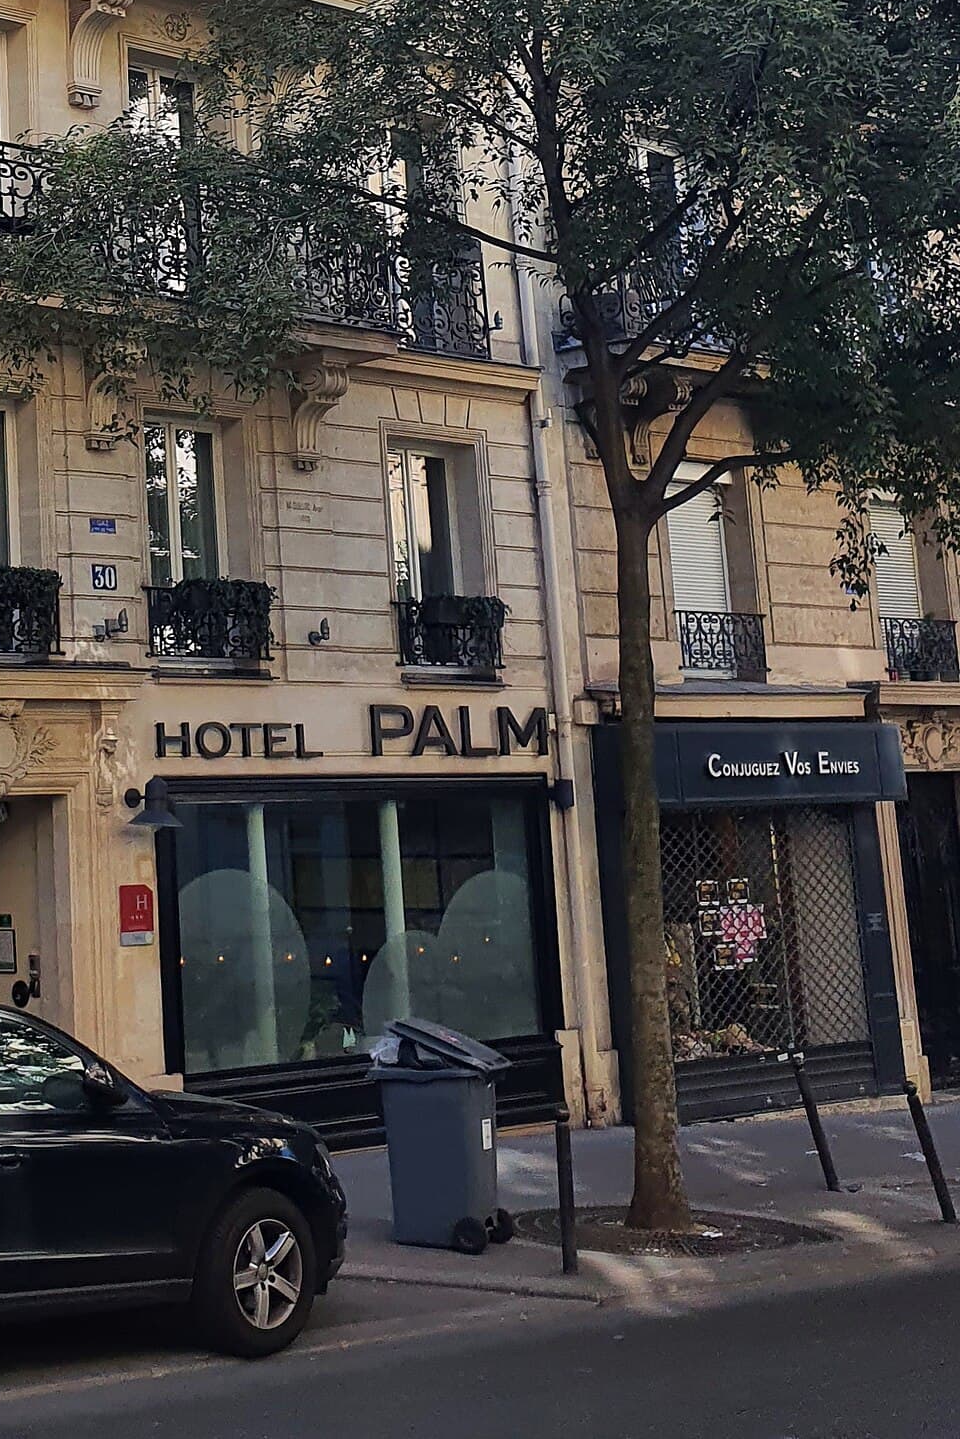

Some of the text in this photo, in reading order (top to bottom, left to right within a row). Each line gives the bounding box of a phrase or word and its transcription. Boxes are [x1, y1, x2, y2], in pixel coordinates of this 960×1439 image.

[95, 565, 116, 589] 30
[154, 703, 549, 759] HOTEL PALM
[136, 894, 148, 911] H
